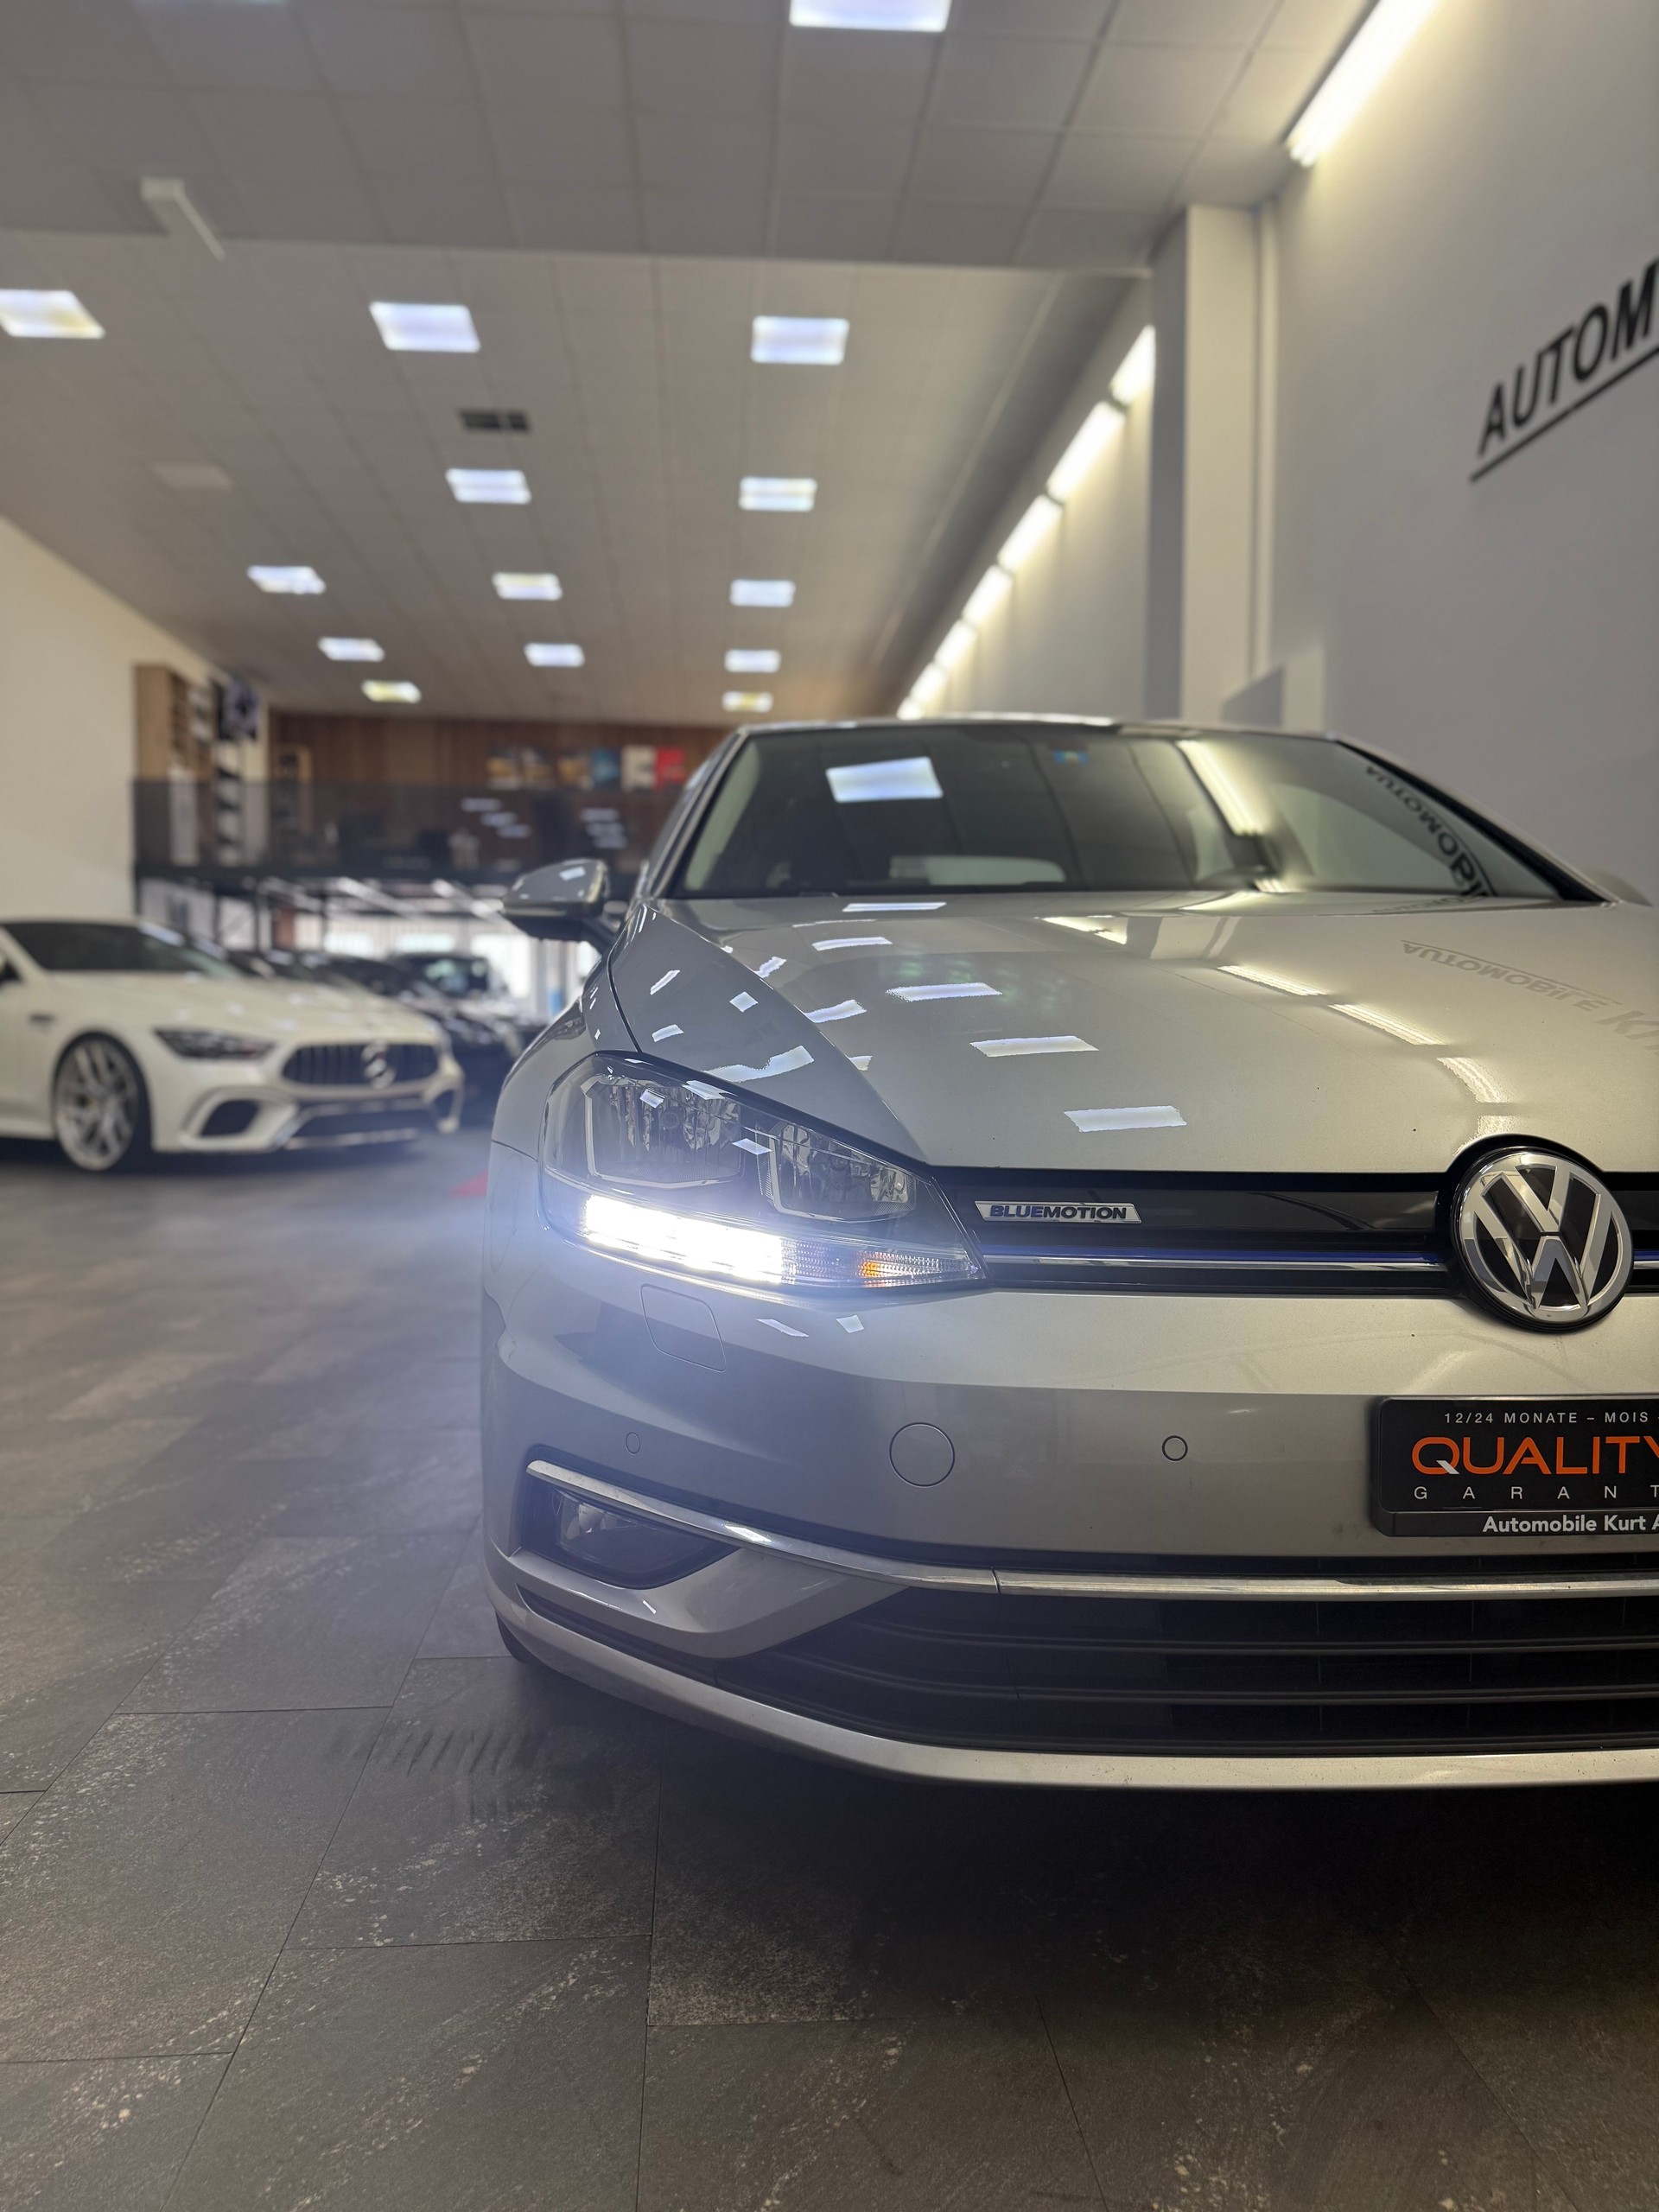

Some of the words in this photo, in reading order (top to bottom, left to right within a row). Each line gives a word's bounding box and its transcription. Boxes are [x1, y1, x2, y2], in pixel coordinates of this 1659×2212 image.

[989, 1204, 1127, 1220] BLUEMOTION
[1444, 1412, 1494, 1424] 12/24
[1503, 1411, 1578, 1424] MONATE
[1605, 1411, 1649, 1424] MOIS
[1482, 1515, 1597, 1533] Automobile
[1604, 1514, 1647, 1531] Kurt
